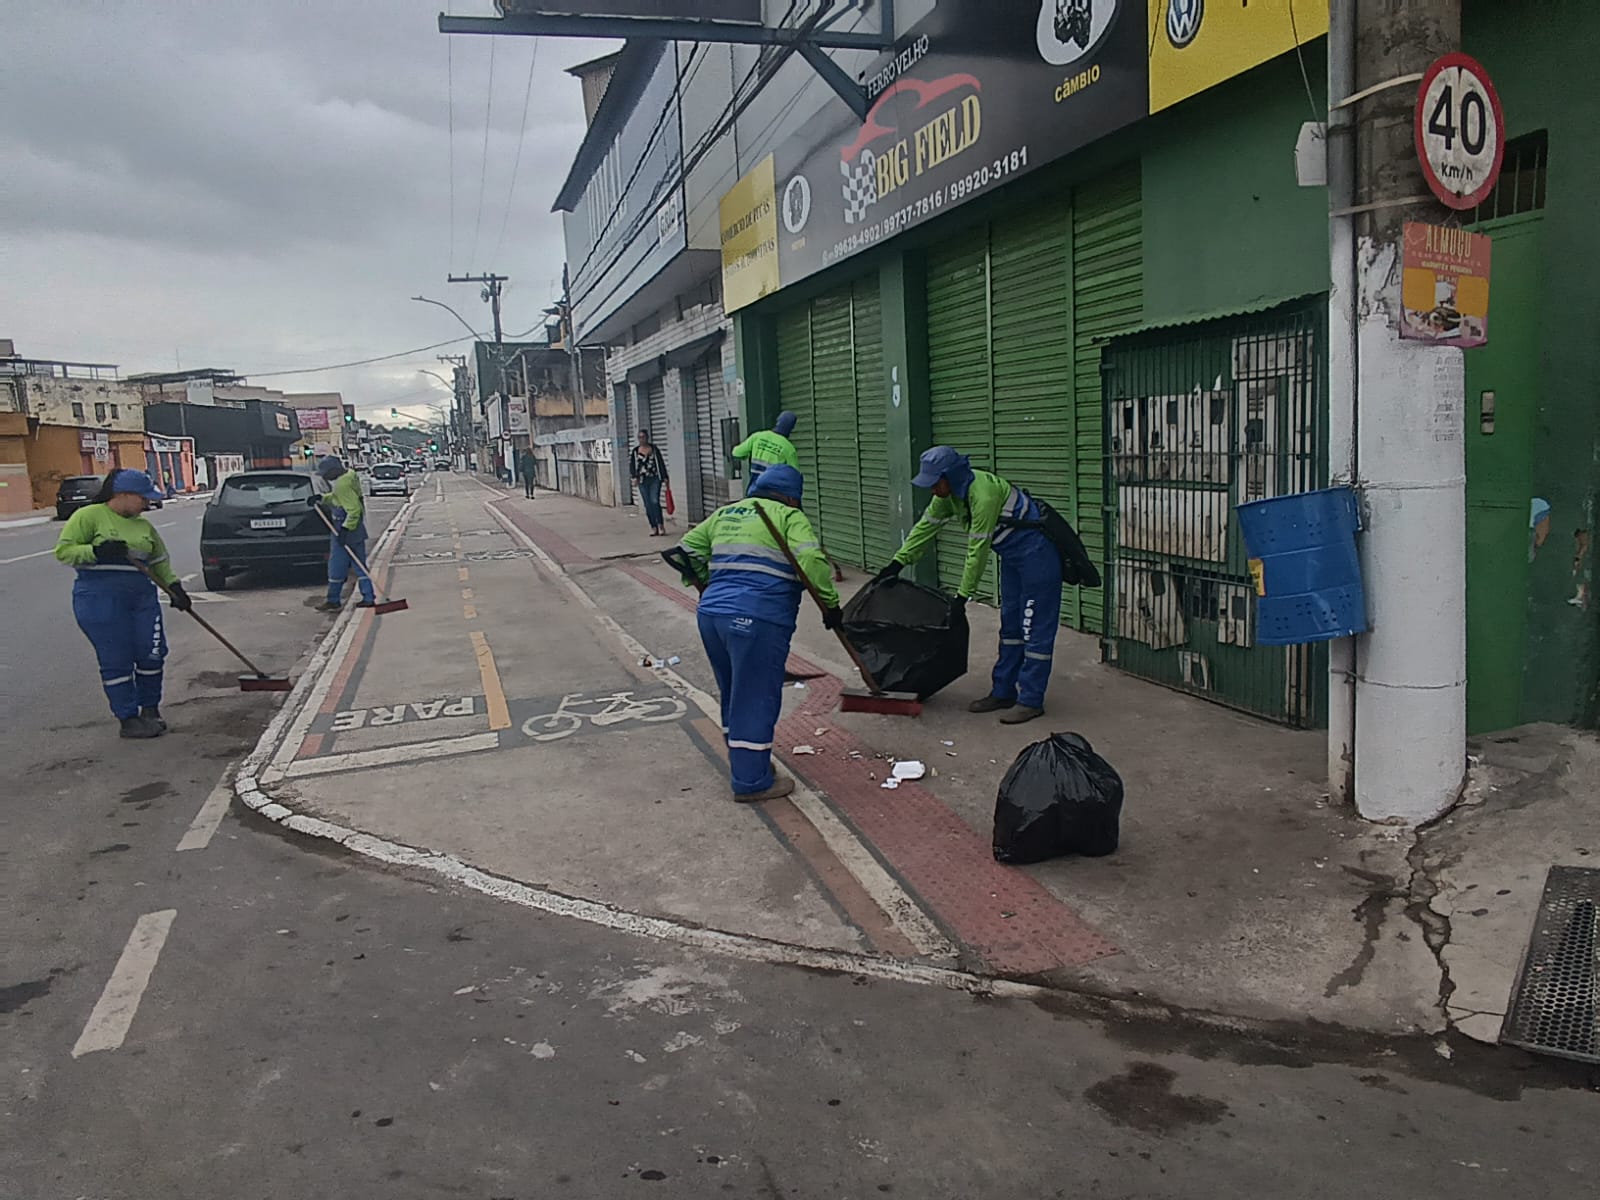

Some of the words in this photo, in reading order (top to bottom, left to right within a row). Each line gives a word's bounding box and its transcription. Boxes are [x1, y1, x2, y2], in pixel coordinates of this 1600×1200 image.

[868, 62, 895, 99] FERRO
[895, 34, 929, 76] VELHO
[876, 139, 909, 199] BIG
[914, 94, 981, 176] FIELD
[1429, 85, 1486, 155] 40
[884, 190, 942, 234] 99737-7816
[951, 146, 1028, 200] 99920-3181
[1022, 600, 1035, 641] FORTE
[330, 696, 475, 732] PARE
